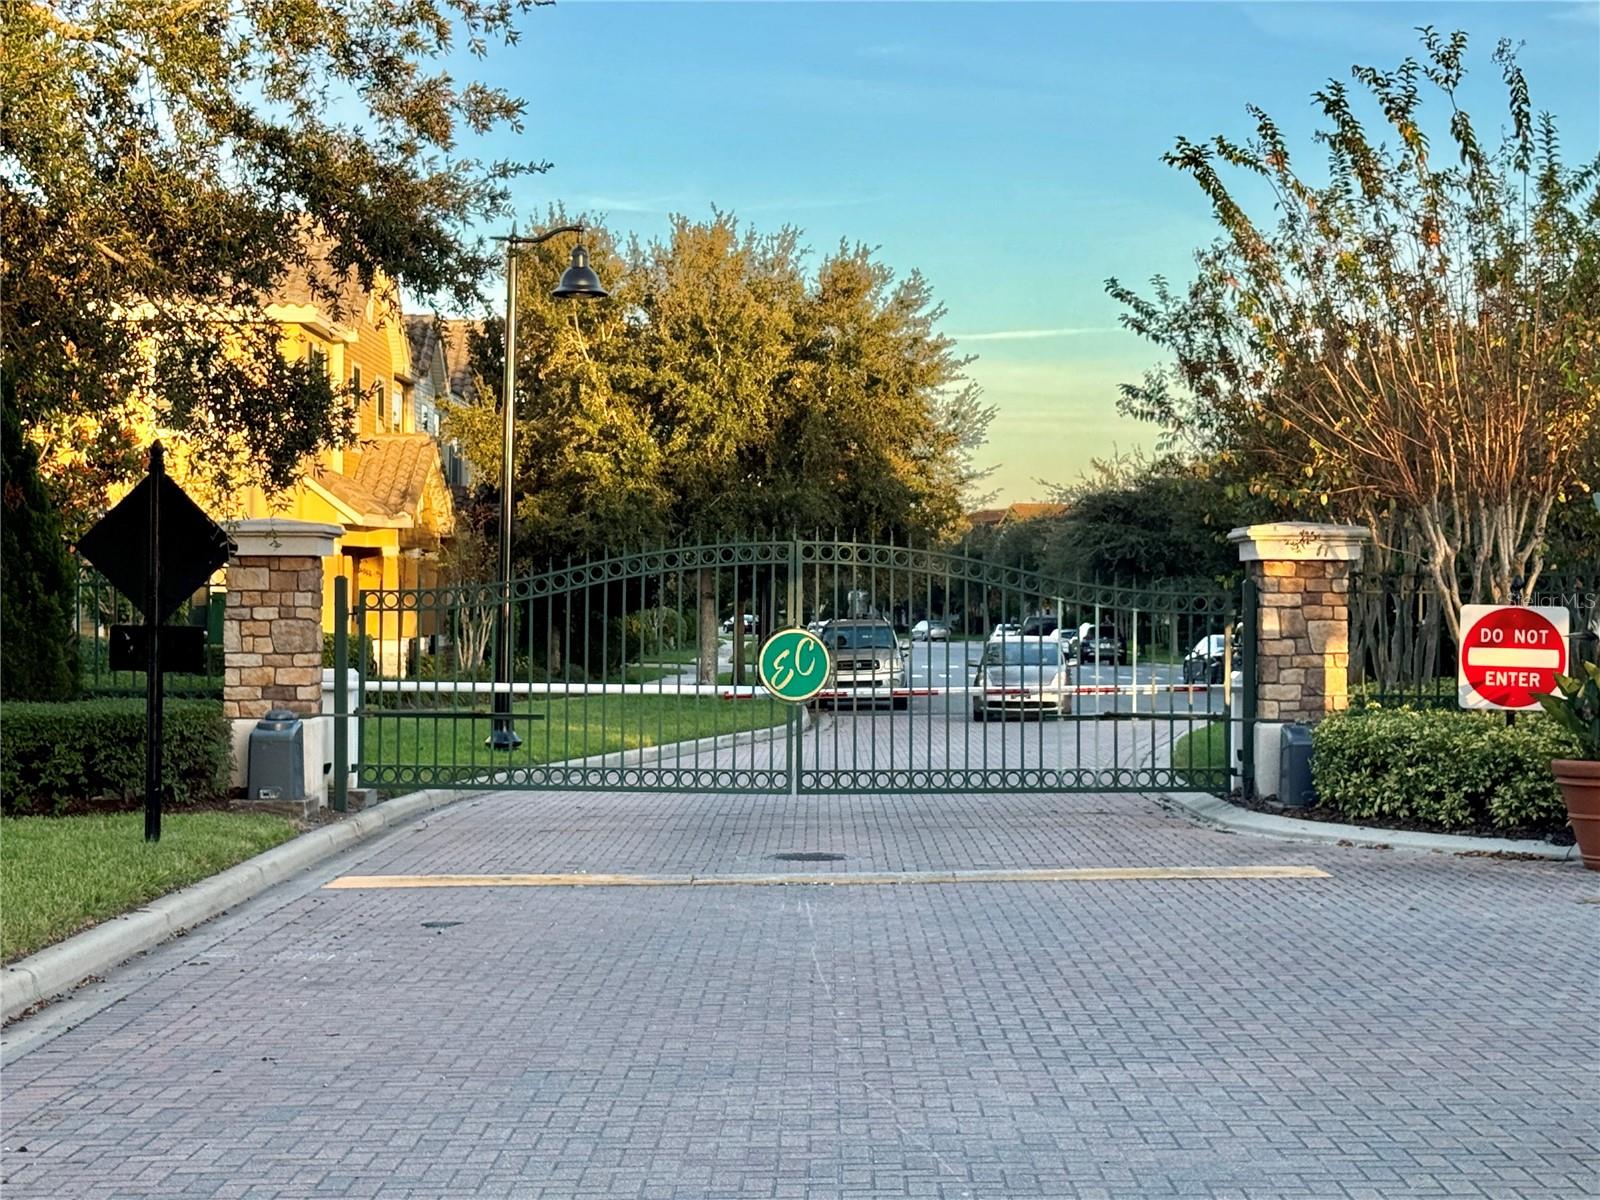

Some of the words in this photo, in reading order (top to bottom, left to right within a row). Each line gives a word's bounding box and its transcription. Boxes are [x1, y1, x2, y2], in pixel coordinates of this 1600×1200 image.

[1480, 628, 1504, 643] DO
[1514, 628, 1549, 644] NOT
[770, 637, 816, 690] EC
[1485, 671, 1541, 688] ENTER
